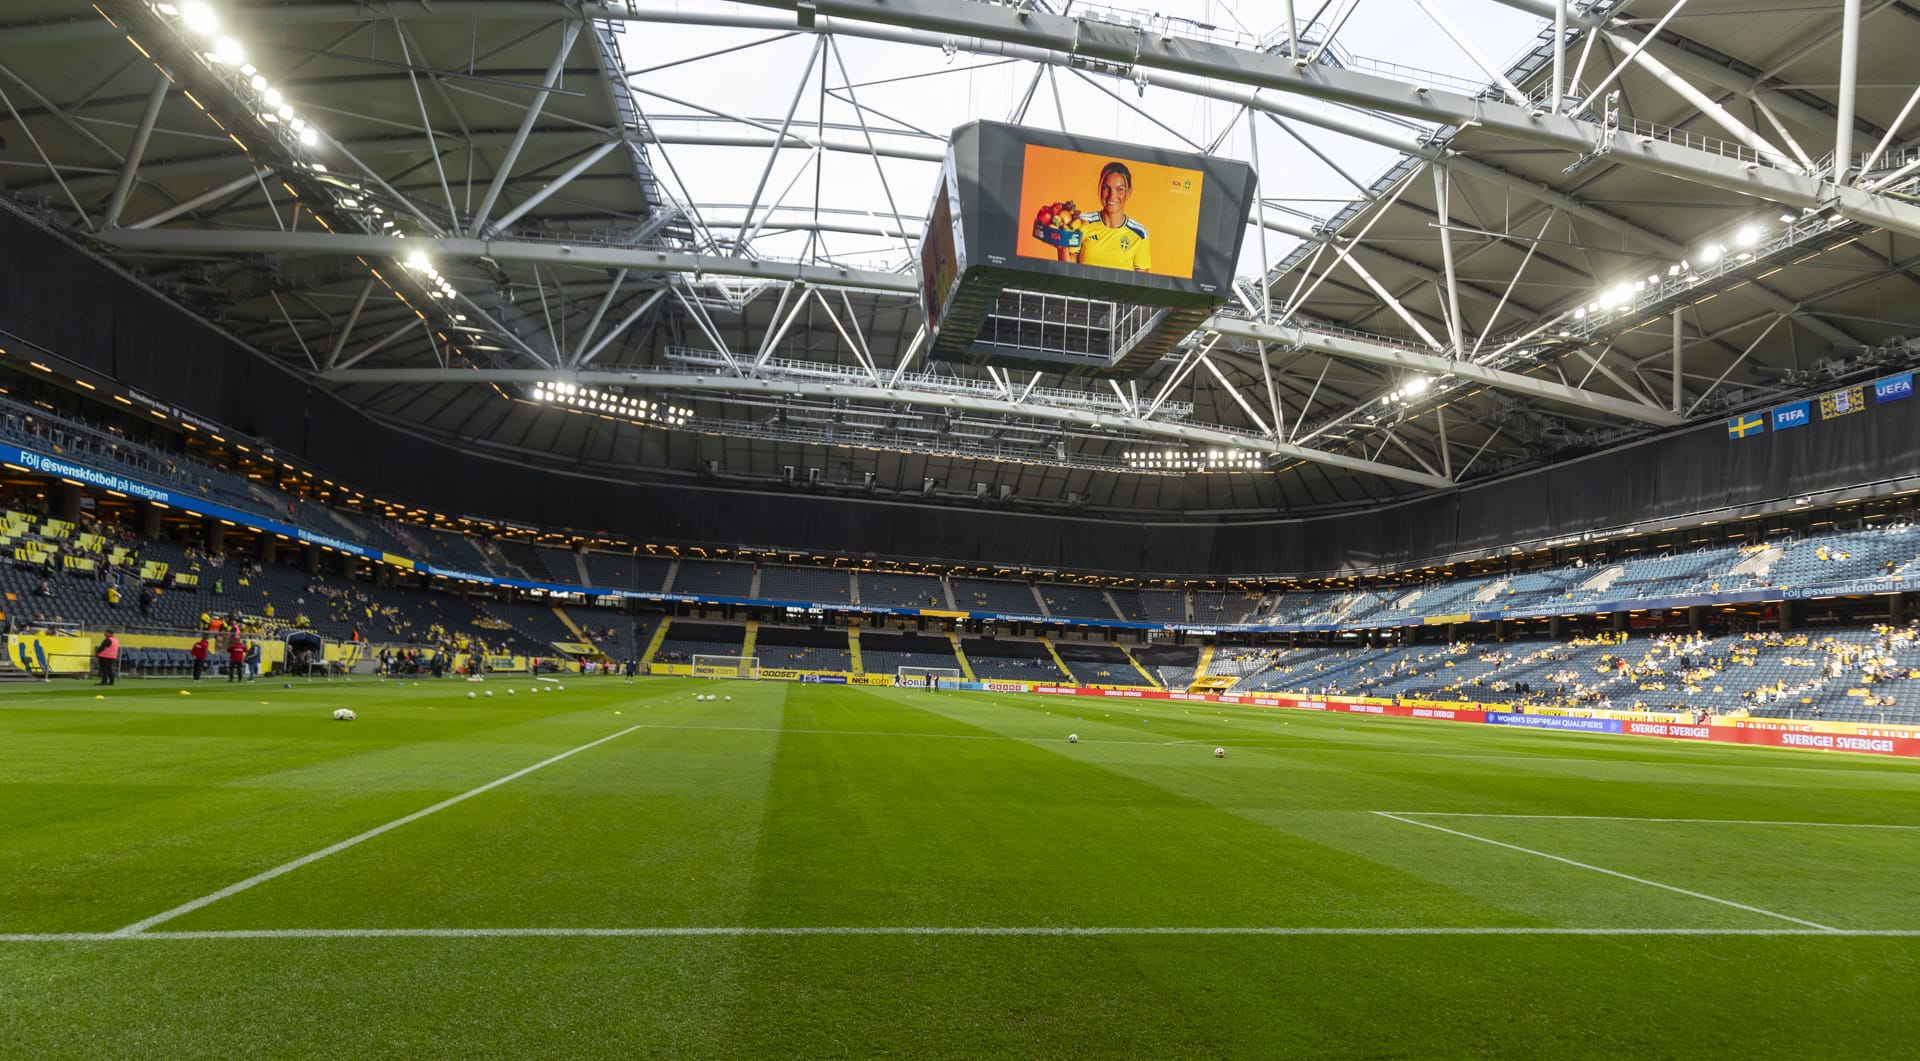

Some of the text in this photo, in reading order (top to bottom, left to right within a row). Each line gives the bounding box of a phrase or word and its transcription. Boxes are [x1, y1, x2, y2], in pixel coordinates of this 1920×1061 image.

[1876, 381, 1911, 396] UEFA
[1778, 410, 1805, 423] FIFA
[20, 451, 168, 501] Följ @svenskfotboll på instagram
[1802, 579, 1893, 597] @svenskfotboll
[762, 669, 798, 678] ODDSET
[1412, 708, 1455, 719] SVERIGE! SVERIGE!
[1460, 704, 1496, 713] Scadic
[1497, 715, 1603, 729] WOMEN'S EUROPEAN QUALIFIERS
[1631, 723, 1709, 737] SVERIGE! SVERIGE!
[1782, 733, 1893, 752] SVERIGE! SVERIGE!
